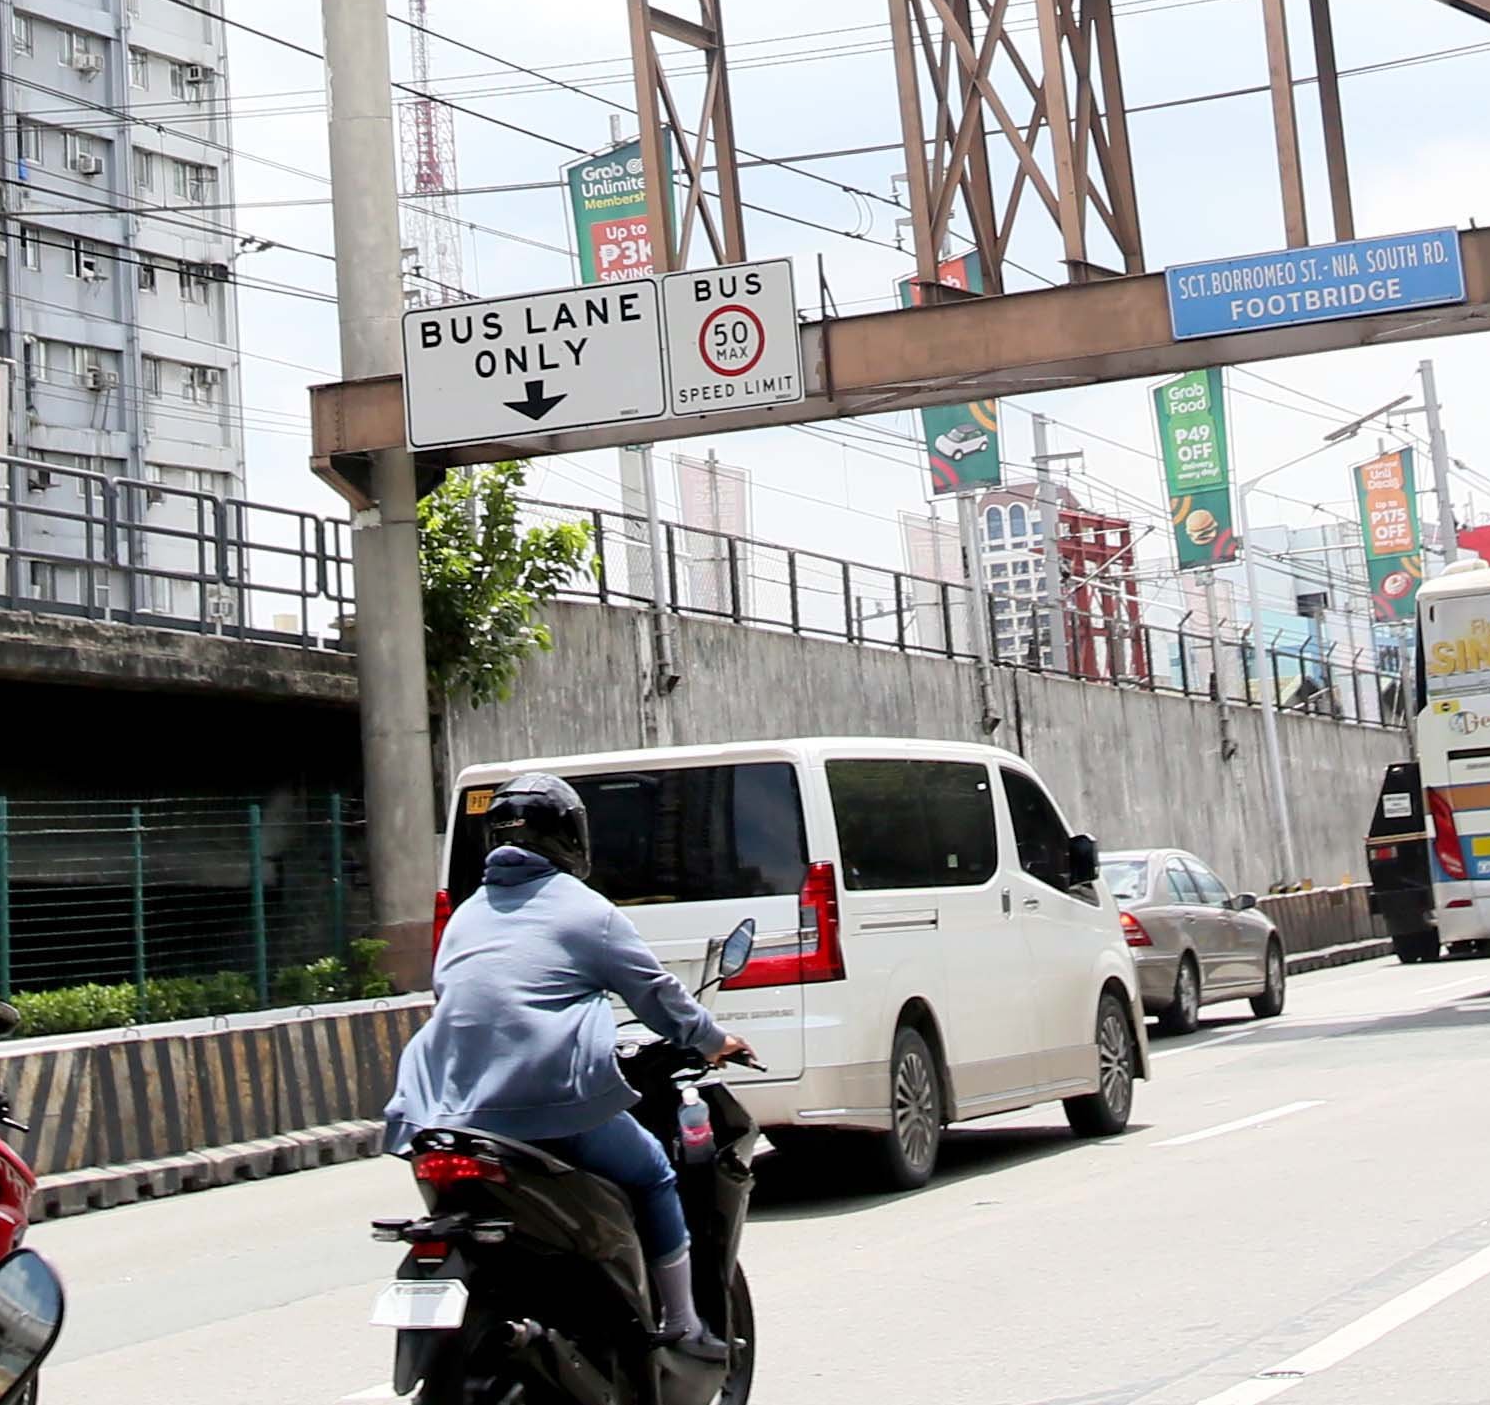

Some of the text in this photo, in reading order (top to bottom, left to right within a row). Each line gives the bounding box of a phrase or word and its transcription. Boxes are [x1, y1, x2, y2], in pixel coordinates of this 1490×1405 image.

[582, 162, 624, 181] Grab
[581, 176, 646, 198] Unlimite
[605, 224, 647, 241] Up to
[600, 265, 654, 282] SAVING
[1178, 274, 1211, 300] SCT.
[1211, 262, 1296, 295] BORROMEO
[1332, 253, 1359, 277] NIA
[1366, 244, 1418, 273] SOUTH
[1423, 240, 1448, 265] RD.
[694, 273, 762, 302] BUS
[1230, 278, 1403, 321] FOOTBRIDGE
[421, 293, 641, 348] BUS LANE
[714, 321, 748, 347] 50
[475, 337, 588, 378] ONLY
[717, 346, 748, 361] MAX
[679, 376, 792, 403] SPEED LIMIT
[1168, 383, 1204, 400] Grab
[1169, 396, 1206, 414] Food
[1178, 442, 1213, 462] OFF
[1375, 524, 1406, 539] OFF
